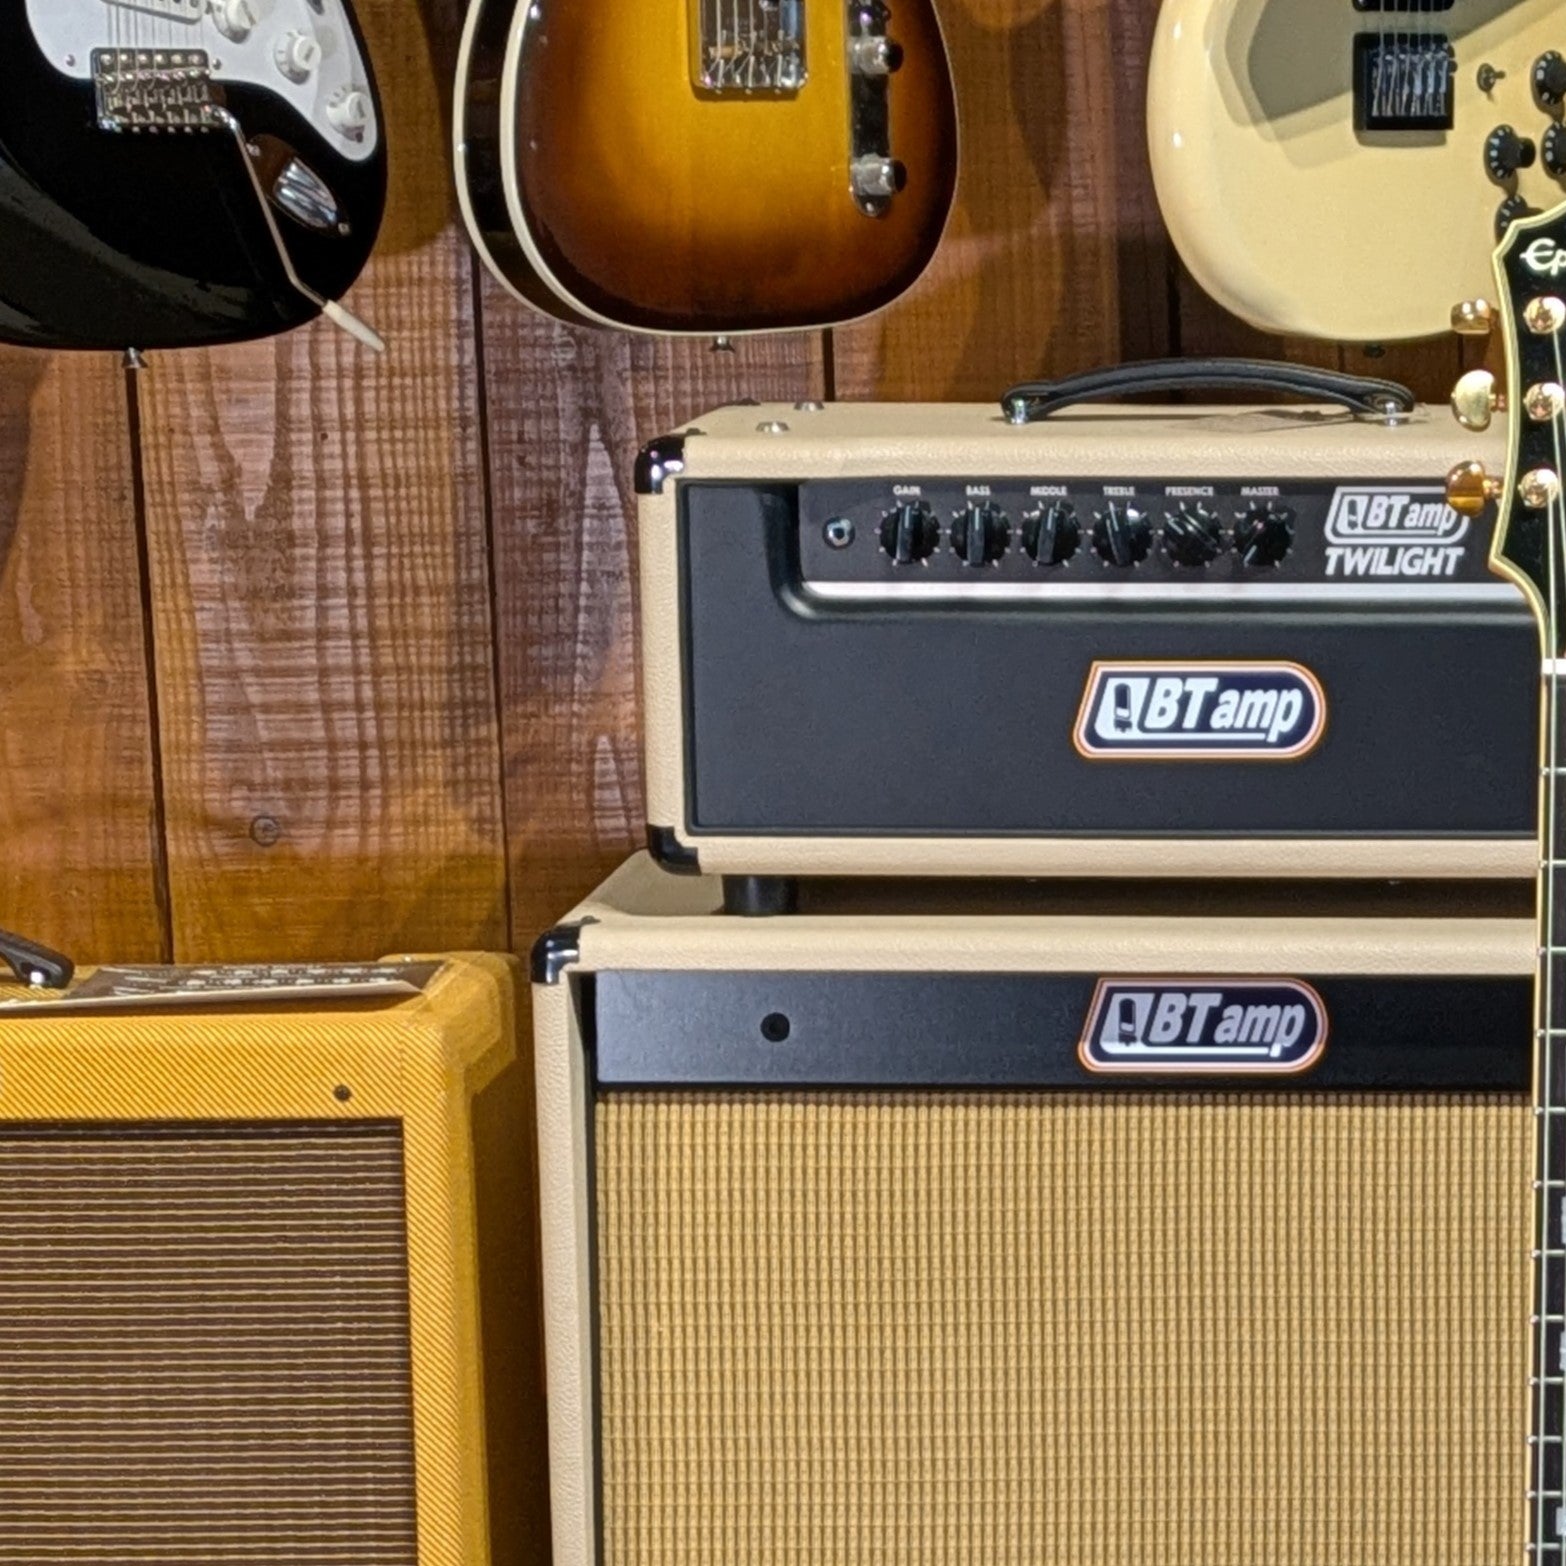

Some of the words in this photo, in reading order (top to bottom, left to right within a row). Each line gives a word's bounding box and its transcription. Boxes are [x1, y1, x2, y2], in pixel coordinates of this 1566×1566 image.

[893, 485, 921, 496] GAIN
[966, 485, 991, 496] BASS
[1030, 486, 1067, 496] MIDDLE
[1103, 486, 1135, 497] TREBLE
[1165, 486, 1214, 497] PRESENCE
[1240, 486, 1279, 497] MASTER
[1366, 495, 1410, 529] BT
[1404, 502, 1457, 536] amp
[1325, 547, 1465, 576] TWILIGHT
[1144, 677, 1219, 729] BT
[1209, 688, 1304, 743] amp
[1149, 993, 1223, 1043] BT
[1213, 1003, 1306, 1058] amp
